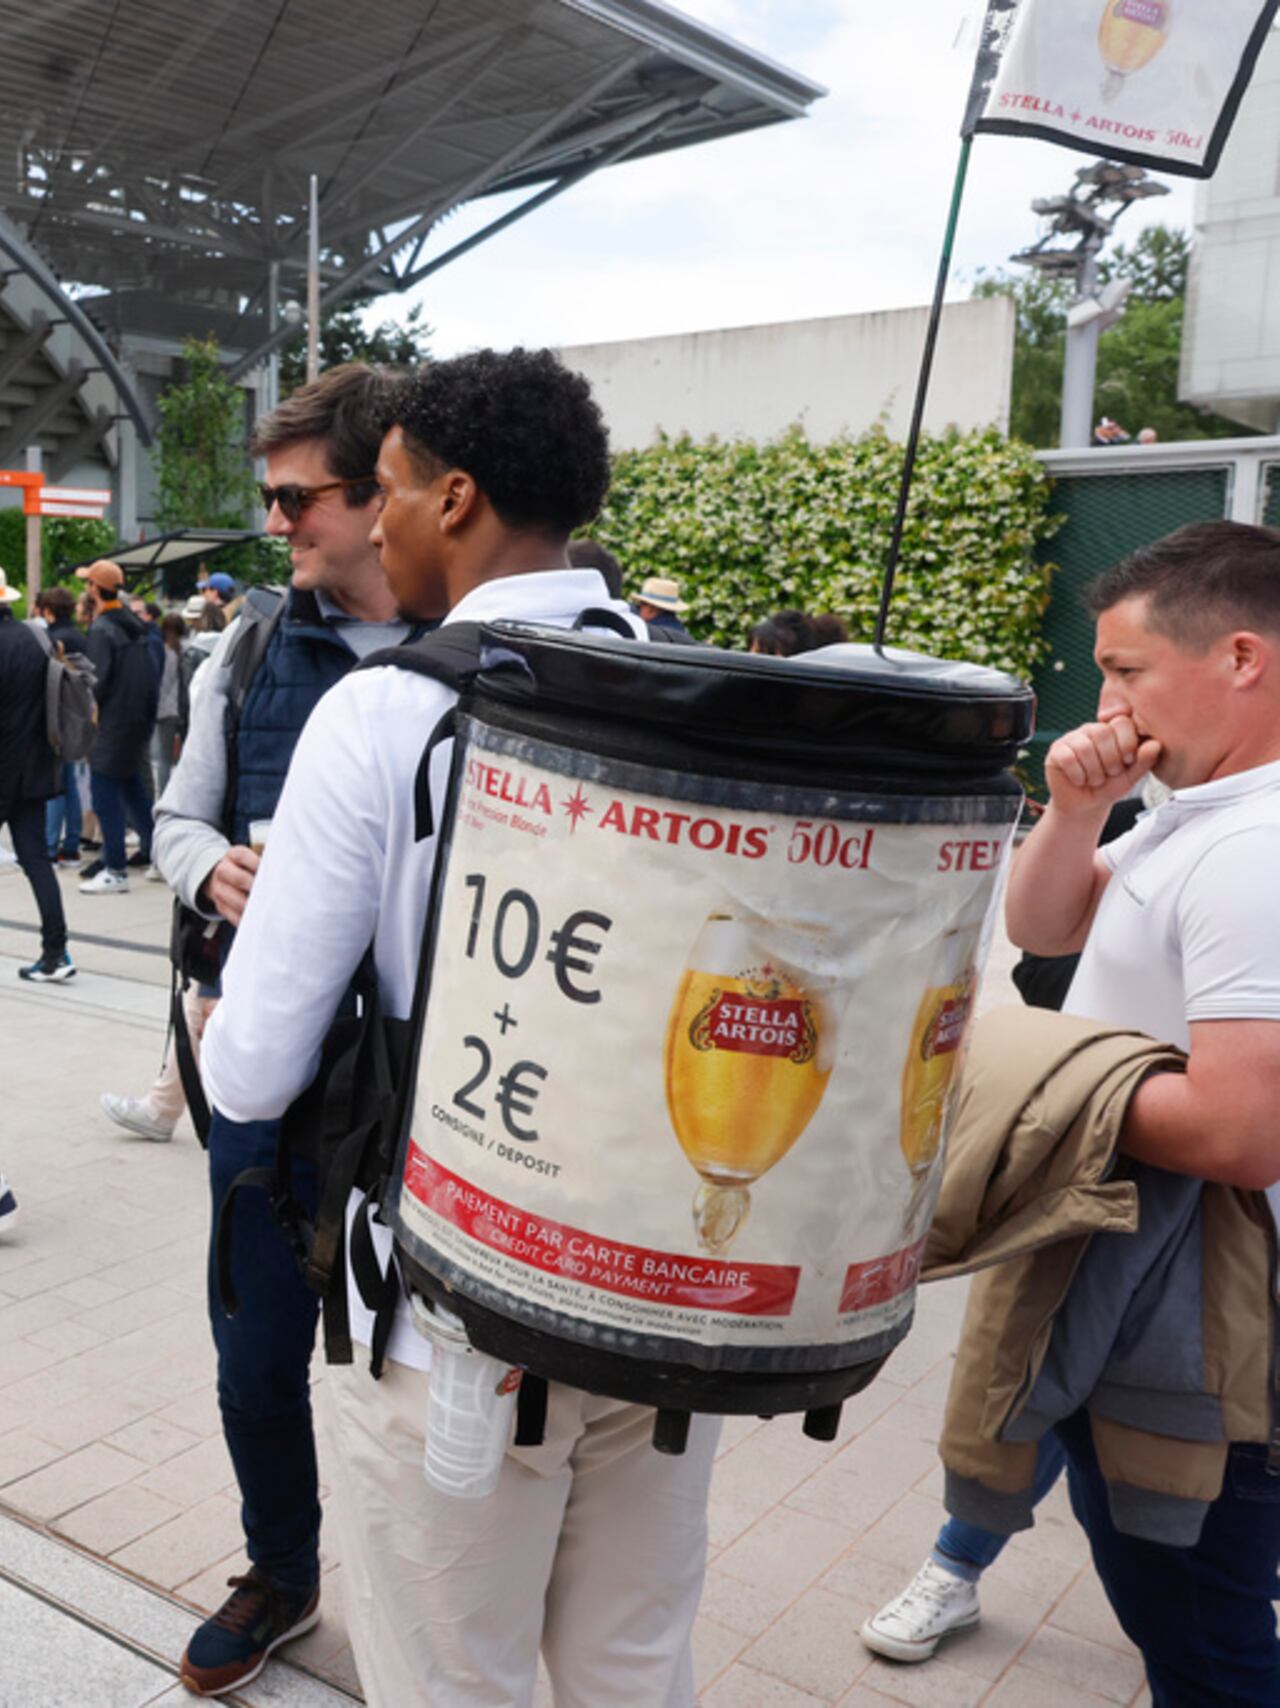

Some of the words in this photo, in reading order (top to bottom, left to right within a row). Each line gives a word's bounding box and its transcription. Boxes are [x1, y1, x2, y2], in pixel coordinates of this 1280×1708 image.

[999, 92, 1064, 119] STELLA
[1085, 115, 1155, 142] ARTOIS
[467, 759, 552, 816] STELLA
[598, 800, 769, 860] ARTOIS
[787, 820, 875, 870] 50cl
[465, 874, 613, 1004] 10€
[714, 1022, 797, 1046] ARTOIS
[719, 1003, 799, 1028] STELLA
[452, 1035, 549, 1142] 2€
[431, 1104, 485, 1146] CONSIGNE
[497, 1143, 561, 1178] DEPOSIT
[447, 1179, 521, 1231] PAIEMENT
[525, 1222, 564, 1248] PAR
[569, 1237, 635, 1271] CARTE
[642, 1258, 751, 1287] BANCAIRE
[589, 1266, 673, 1296] PAYMENT
[677, 1312, 707, 1326] AVEC
